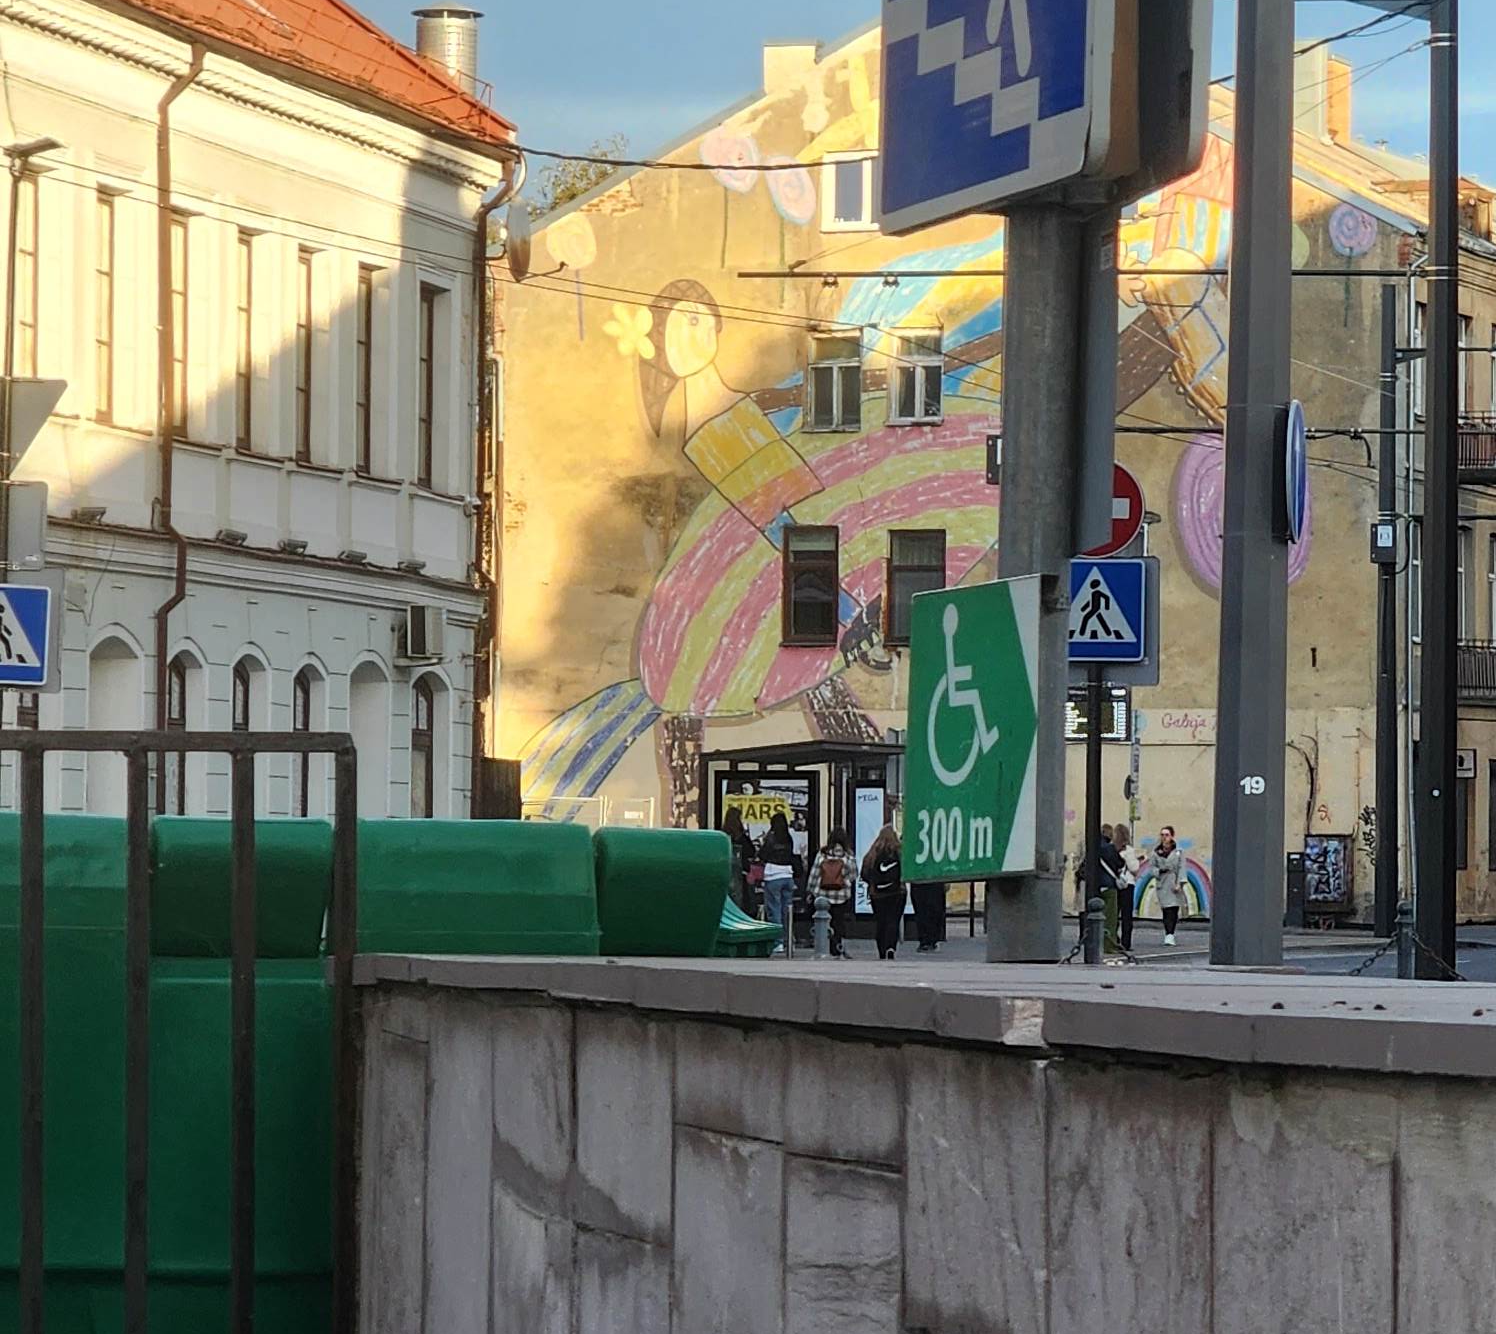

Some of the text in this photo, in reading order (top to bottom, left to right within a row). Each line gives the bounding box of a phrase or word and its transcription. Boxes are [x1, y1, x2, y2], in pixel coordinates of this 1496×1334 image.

[1239, 776, 1266, 795] 19
[915, 806, 993, 864] 300 m
